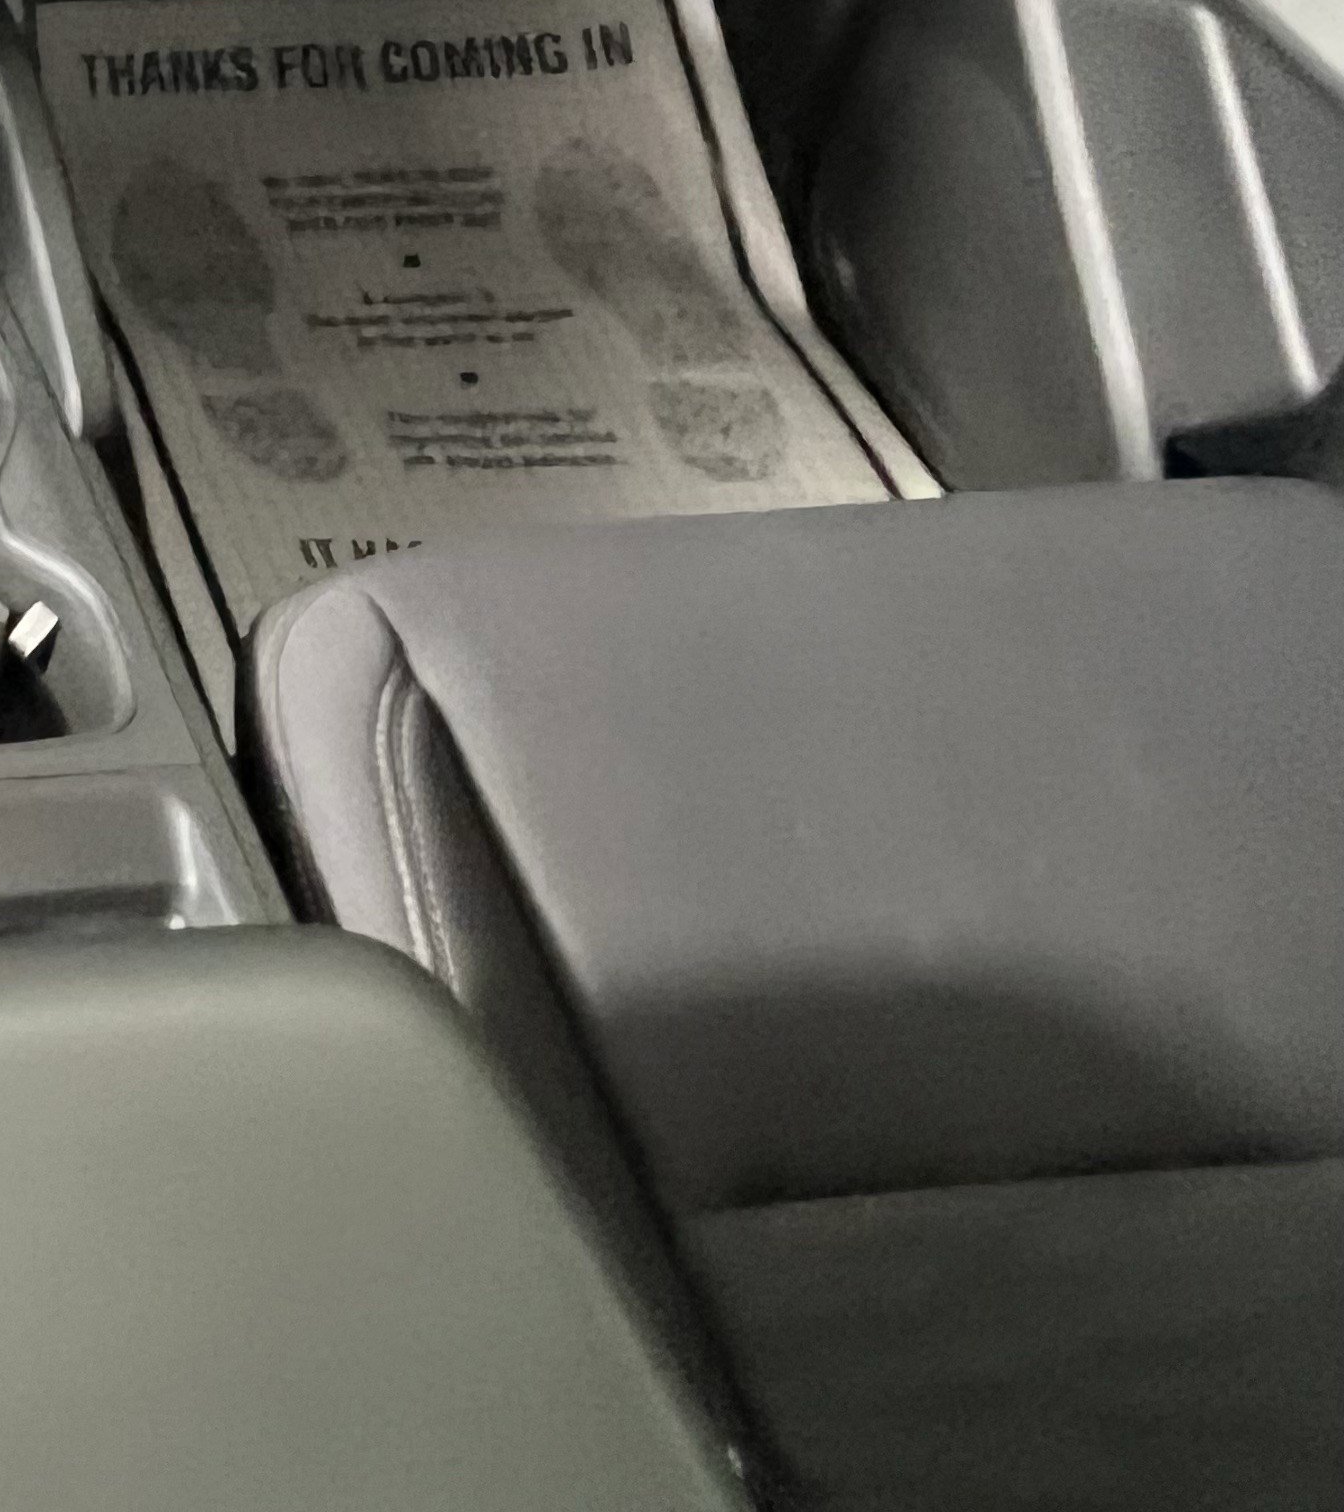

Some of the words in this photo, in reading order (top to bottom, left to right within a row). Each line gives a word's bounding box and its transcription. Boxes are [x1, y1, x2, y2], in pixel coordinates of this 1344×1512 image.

[81, 45, 259, 98] THANKS
[272, 43, 368, 92] FOR
[381, 32, 568, 83] COMING
[582, 21, 634, 71] IN
[299, 537, 339, 569] IT
